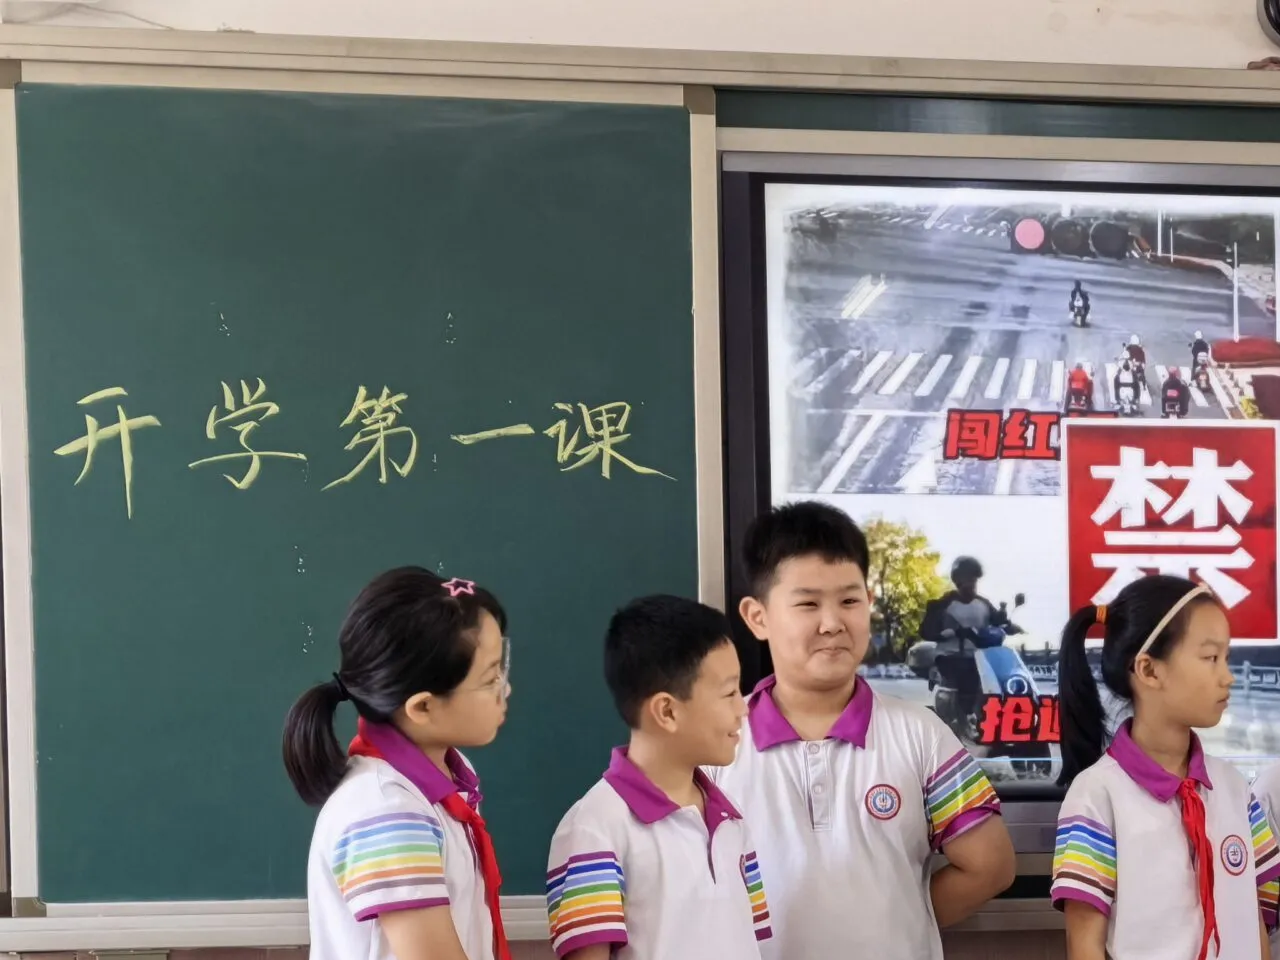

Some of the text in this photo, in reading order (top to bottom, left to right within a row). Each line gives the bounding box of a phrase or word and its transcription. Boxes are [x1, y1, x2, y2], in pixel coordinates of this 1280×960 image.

[54, 377, 678, 519] 开学第一课
[944, 409, 1118, 461] 闯红
